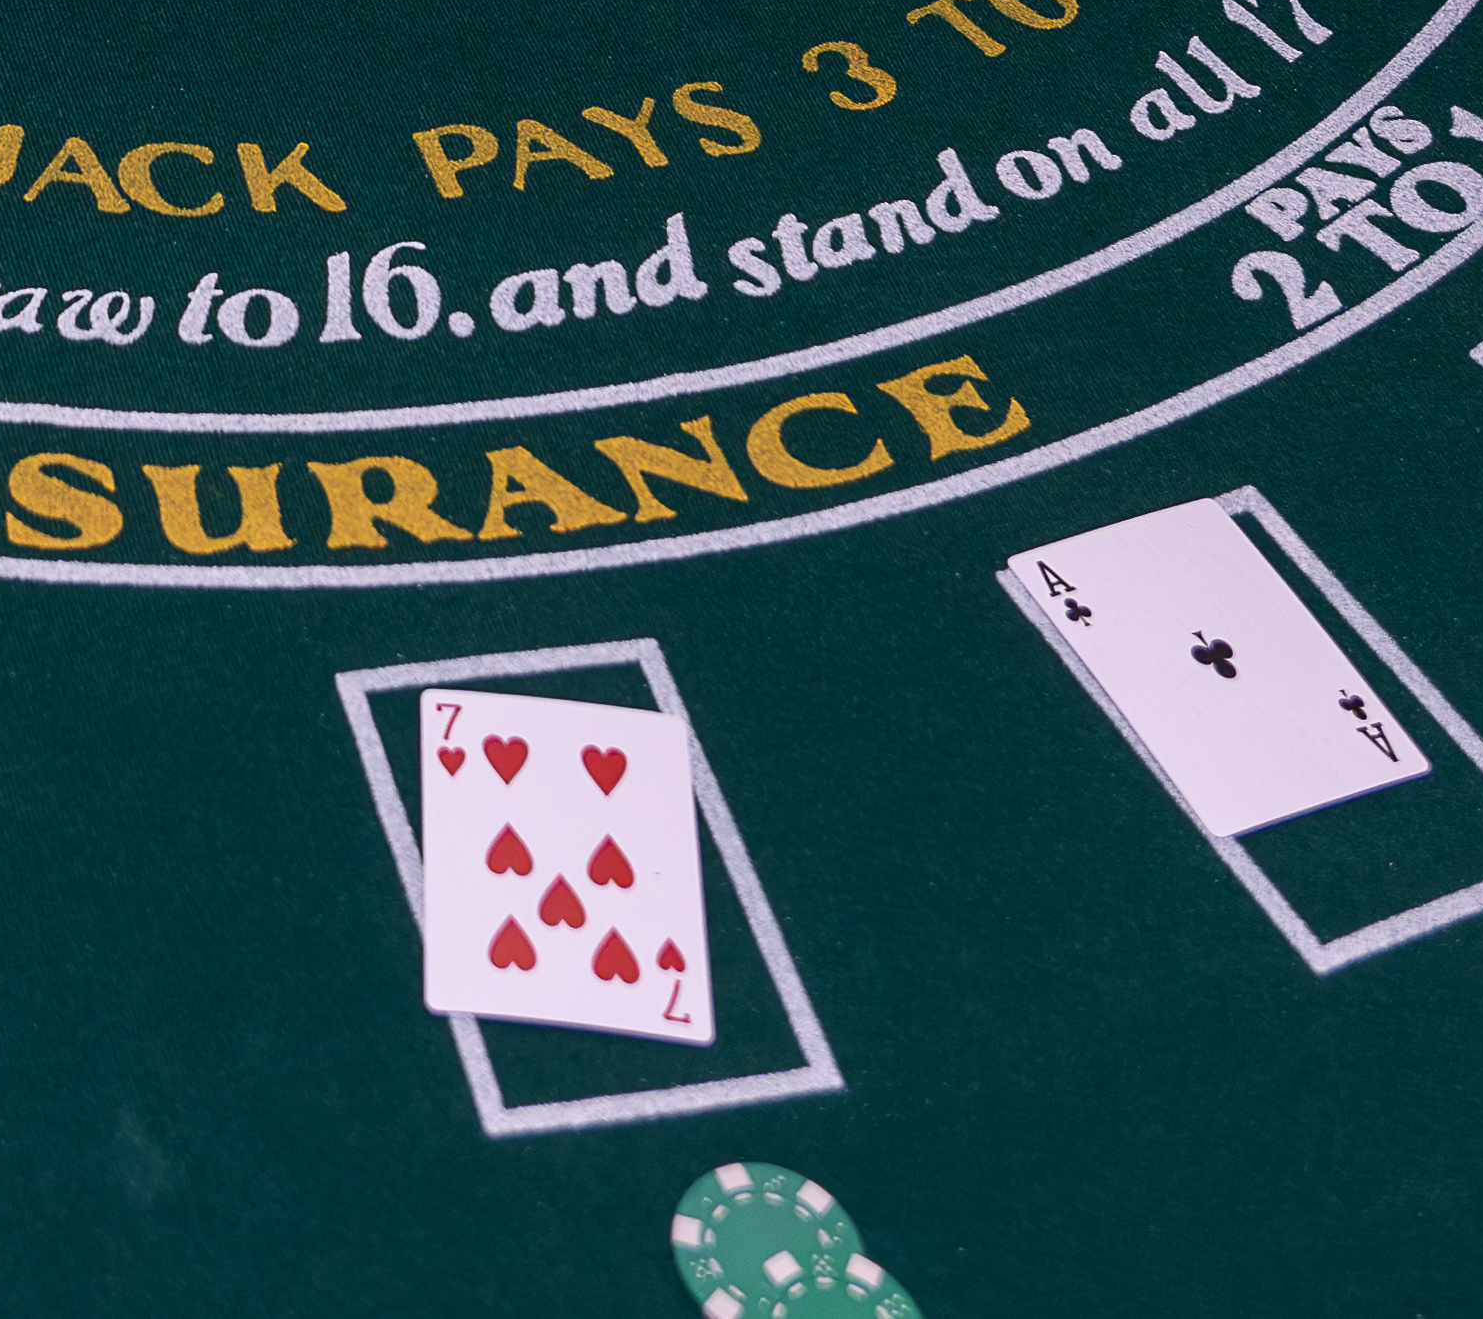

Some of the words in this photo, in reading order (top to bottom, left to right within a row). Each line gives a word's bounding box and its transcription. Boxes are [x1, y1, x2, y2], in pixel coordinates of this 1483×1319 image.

[413, 82, 761, 198] PAYS
[802, 41, 897, 110] 3
[178, 273, 299, 347] to
[490, 212, 708, 332] and
[728, 147, 1000, 296] stand
[996, 129, 1122, 200] on
[1130, 36, 1262, 142] all
[1245, 105, 1432, 242] PAYS
[1231, 250, 1343, 330] 2
[1037, 561, 1076, 597] A
[435, 703, 463, 741] 7
[1357, 722, 1399, 762] A
[663, 979, 692, 1024] 7
